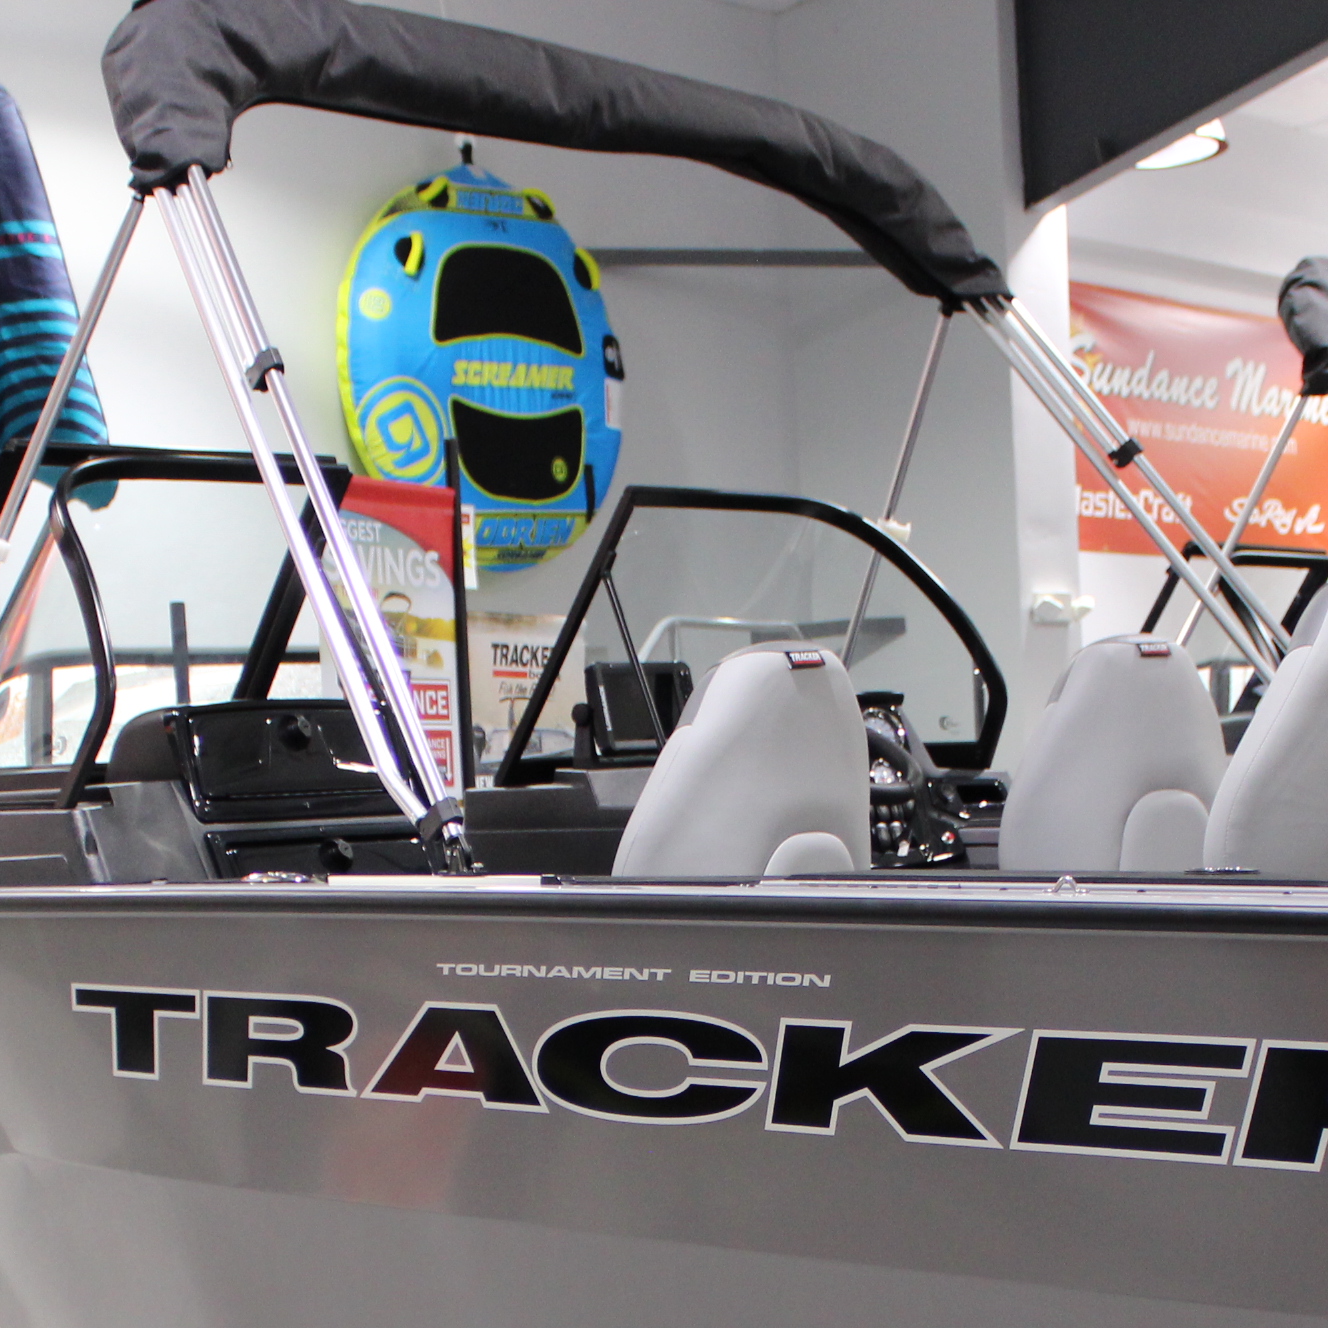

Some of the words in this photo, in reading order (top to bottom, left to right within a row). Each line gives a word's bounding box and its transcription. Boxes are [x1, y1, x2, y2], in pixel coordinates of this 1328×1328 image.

[451, 359, 576, 391] SCREAMER
[1068, 332, 1221, 411] Sundance
[491, 642, 554, 668] TRACKE
[789, 651, 822, 662] TRACKER
[436, 963, 672, 982] TOURNAMENT
[688, 969, 832, 988] EDITION
